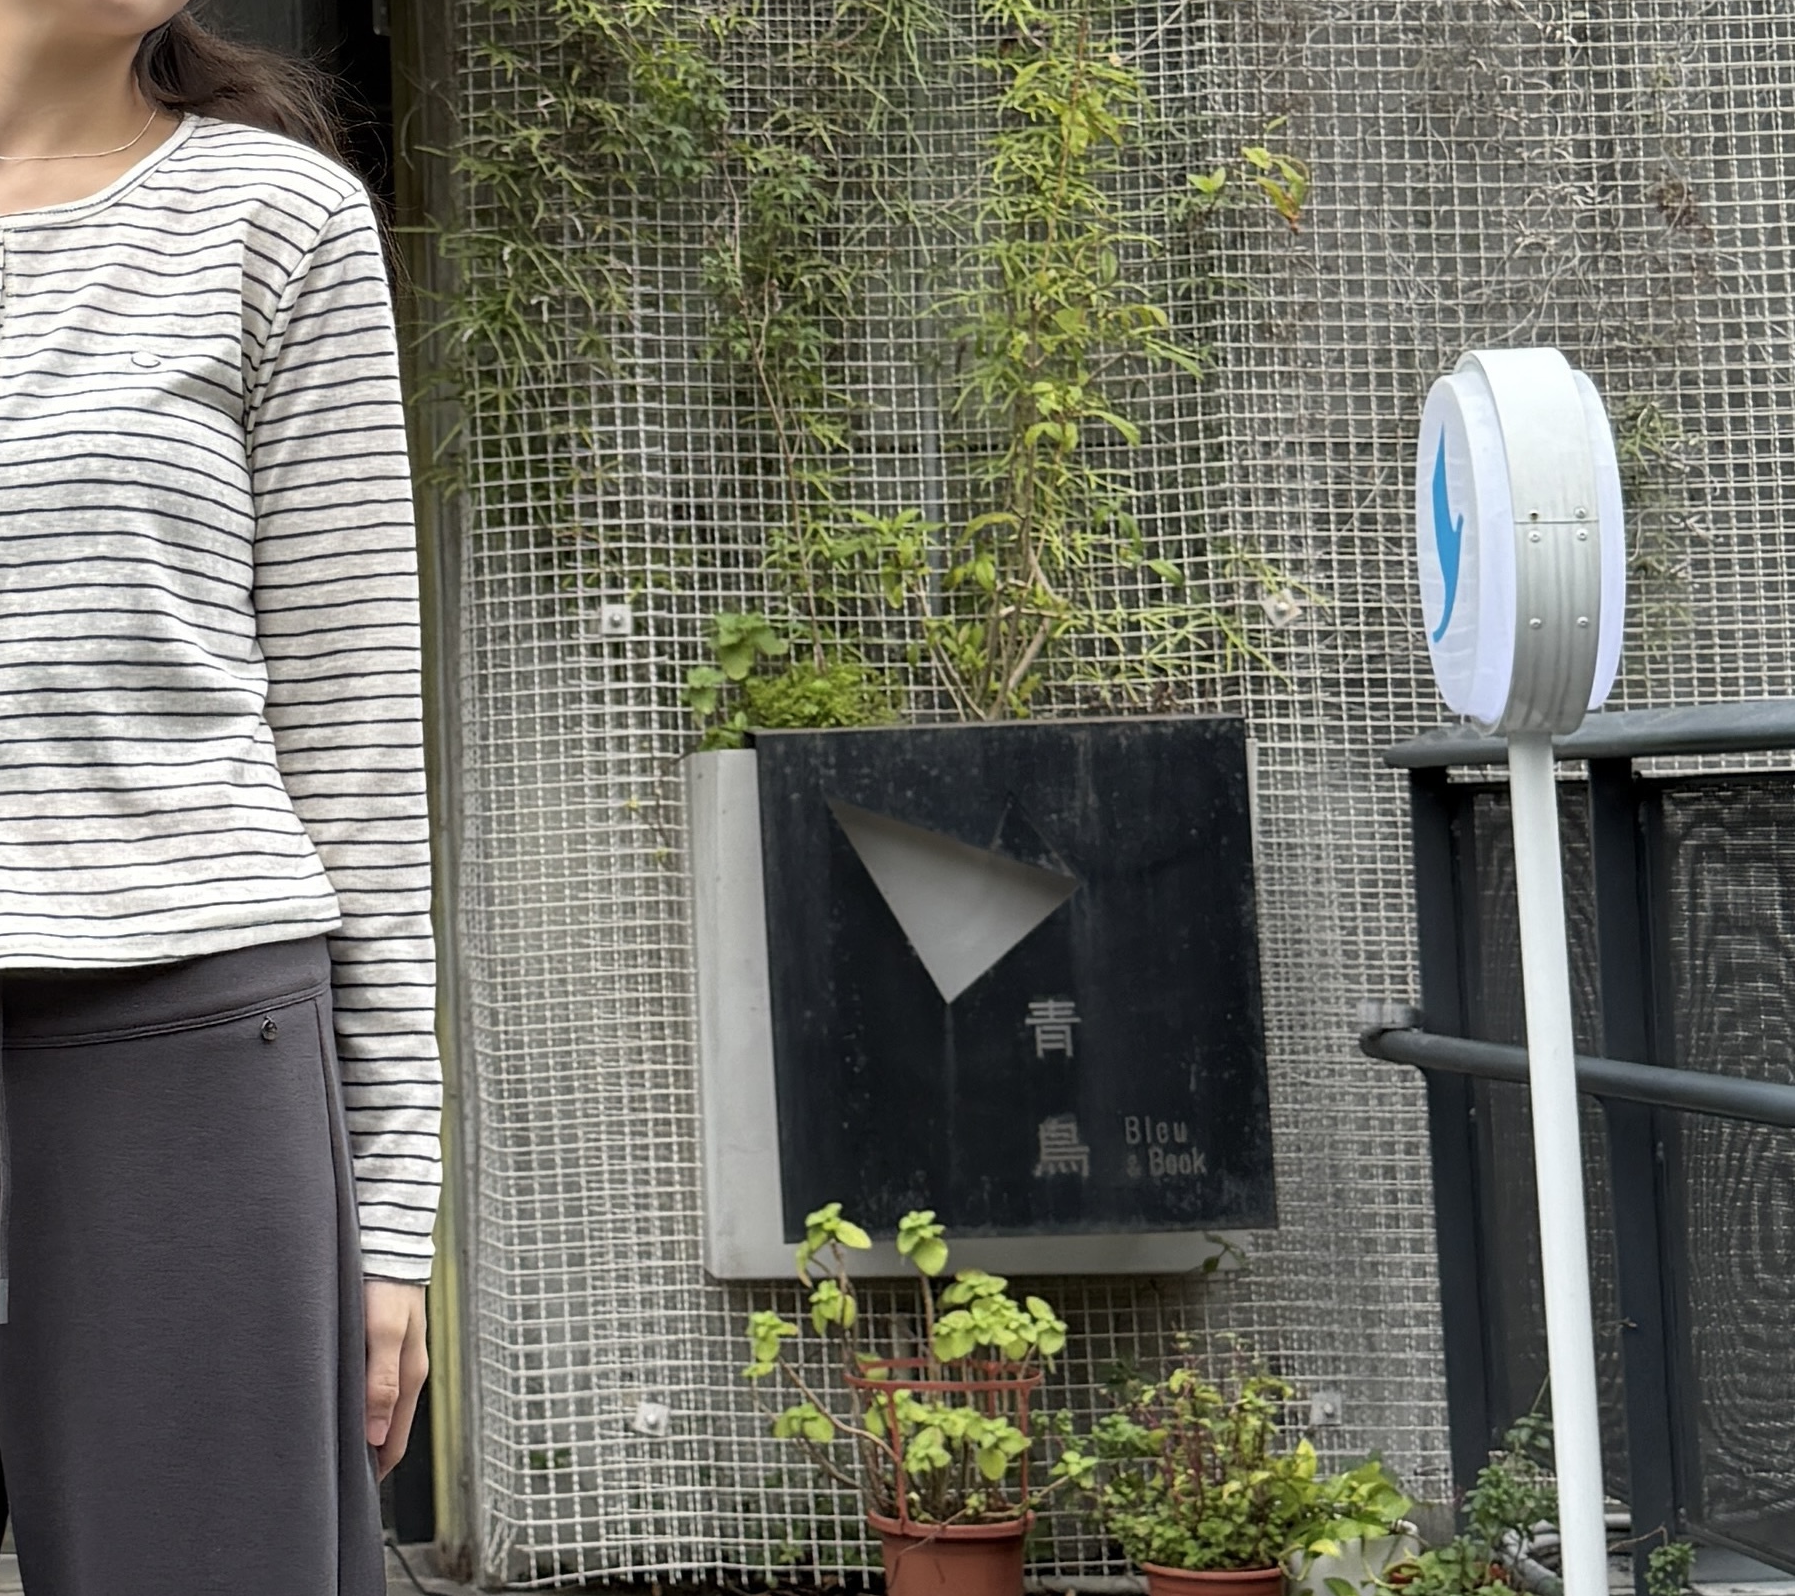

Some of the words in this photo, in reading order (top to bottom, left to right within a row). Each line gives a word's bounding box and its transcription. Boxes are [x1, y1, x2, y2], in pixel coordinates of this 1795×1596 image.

[1024, 999, 1091, 1177] 青鳥
[1124, 1115, 1189, 1144] Bleu
[1148, 1146, 1207, 1176] Book
